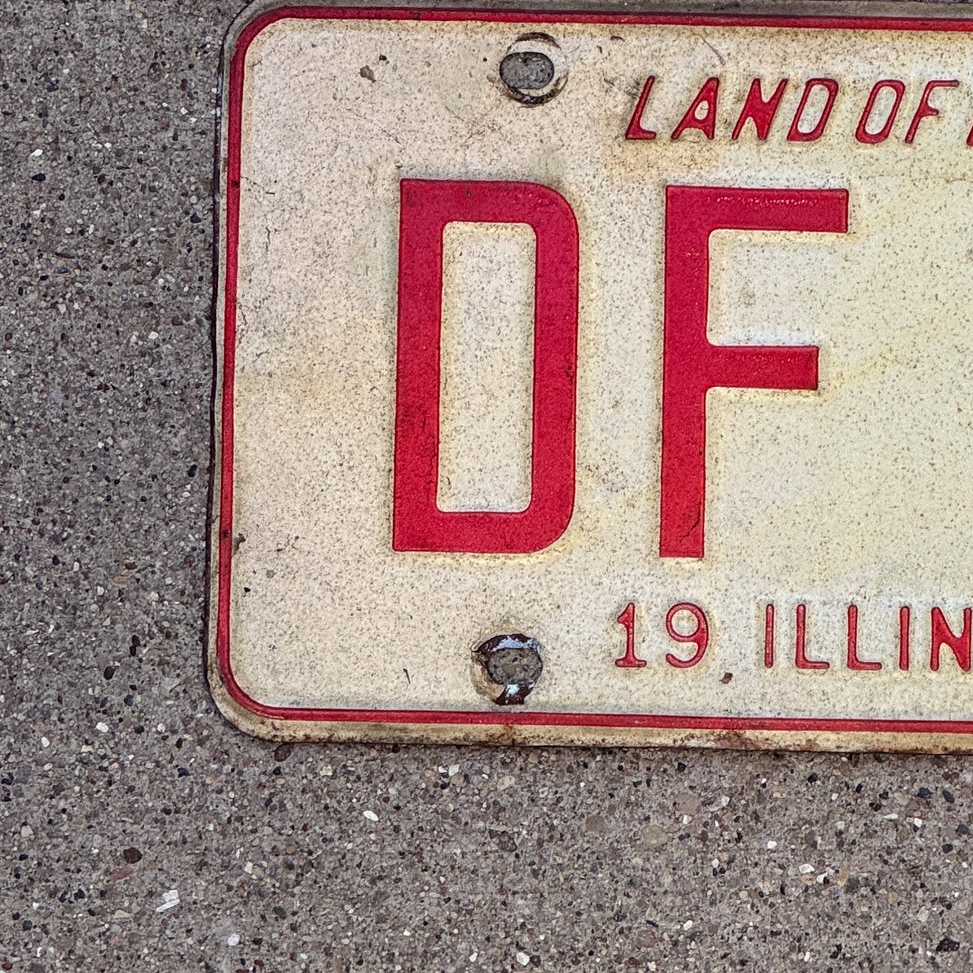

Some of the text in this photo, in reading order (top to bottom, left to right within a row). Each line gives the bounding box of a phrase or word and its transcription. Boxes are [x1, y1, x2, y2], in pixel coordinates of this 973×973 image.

[624, 75, 840, 143] LAND
[854, 78, 958, 145] OF
[391, 177, 850, 560] DF
[614, 601, 711, 670] 19
